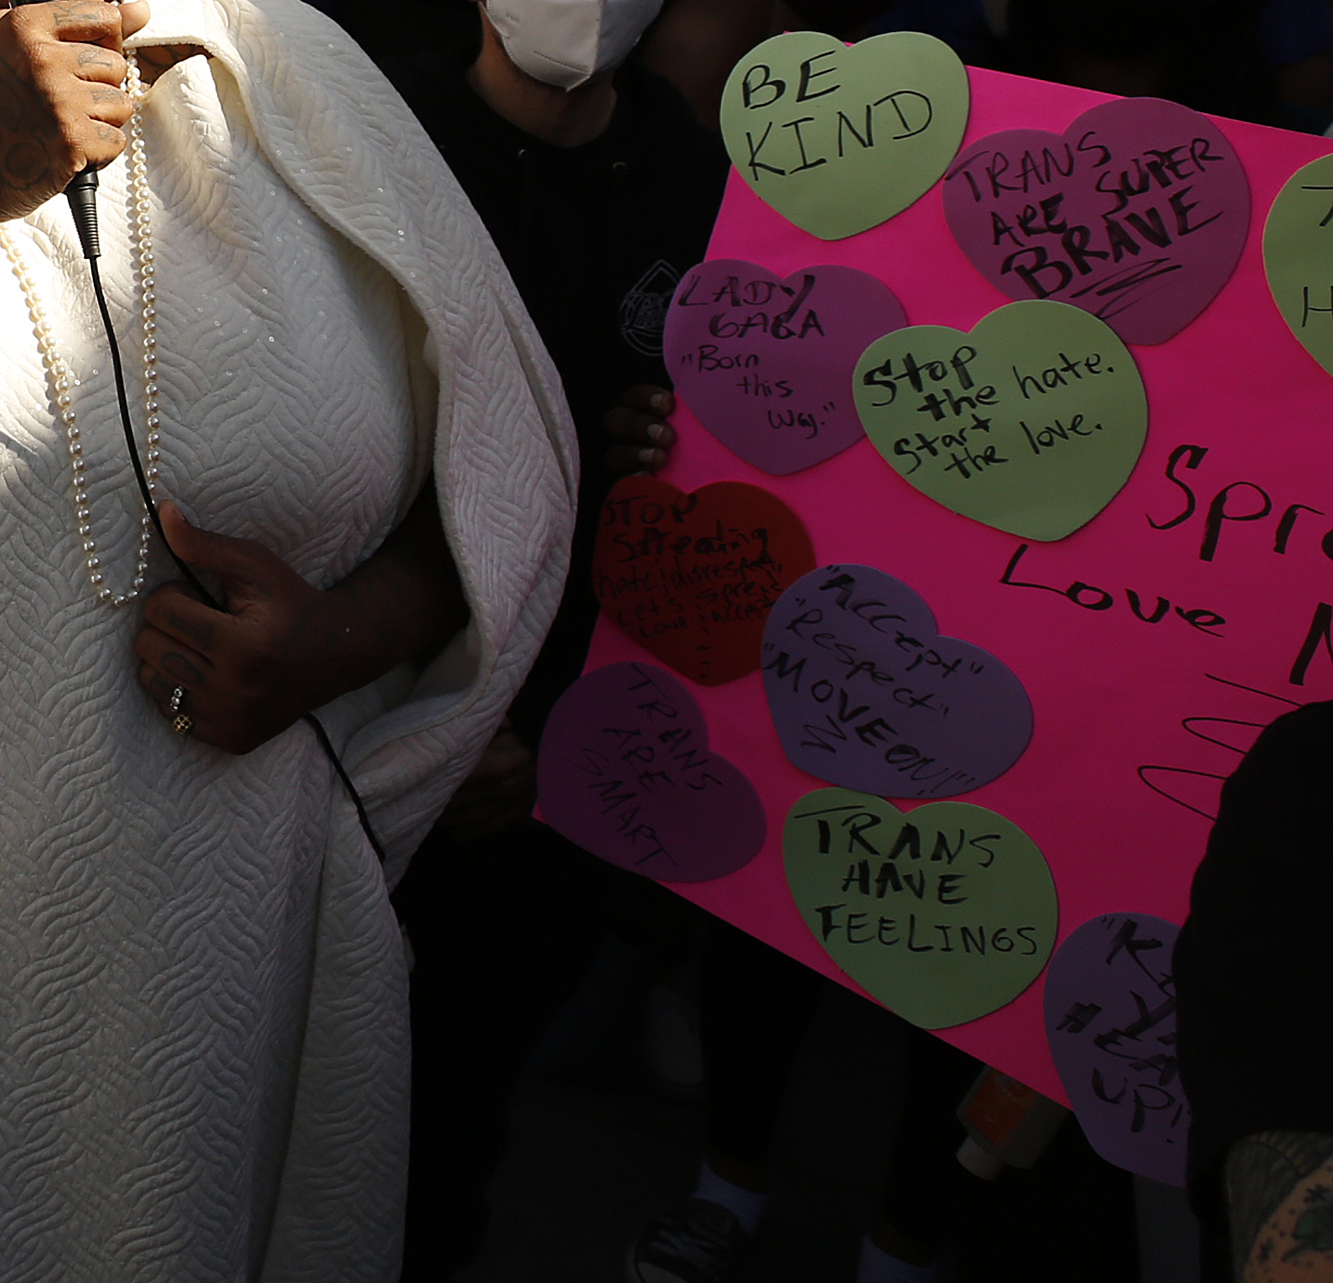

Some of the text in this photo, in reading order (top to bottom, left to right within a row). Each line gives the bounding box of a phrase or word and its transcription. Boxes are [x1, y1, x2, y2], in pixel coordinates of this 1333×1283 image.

[742, 50, 840, 110] BE
[745, 90, 933, 181] KIND
[944, 131, 1112, 203] TRANS
[991, 192, 1068, 248] ARE
[1095, 137, 1225, 219] SUPER
[1000, 185, 1224, 300] BRAVE
[678, 274, 816, 323] LADY
[708, 310, 825, 340] GAGA
[736, 373, 794, 398] this
[917, 352, 1115, 422] the hate.
[944, 414, 1103, 480] the love.
[605, 493, 698, 526] STOP
[1145, 444, 1333, 563] Spr
[602, 727, 676, 794] ARE
[629, 663, 723, 791] TRANS
[562, 747, 679, 867] SMART
[794, 805, 1002, 869] TRANS
[842, 859, 969, 905] HAVE
[815, 903, 1037, 956] FEELINGS
[1055, 1001, 1178, 1086] HEA
